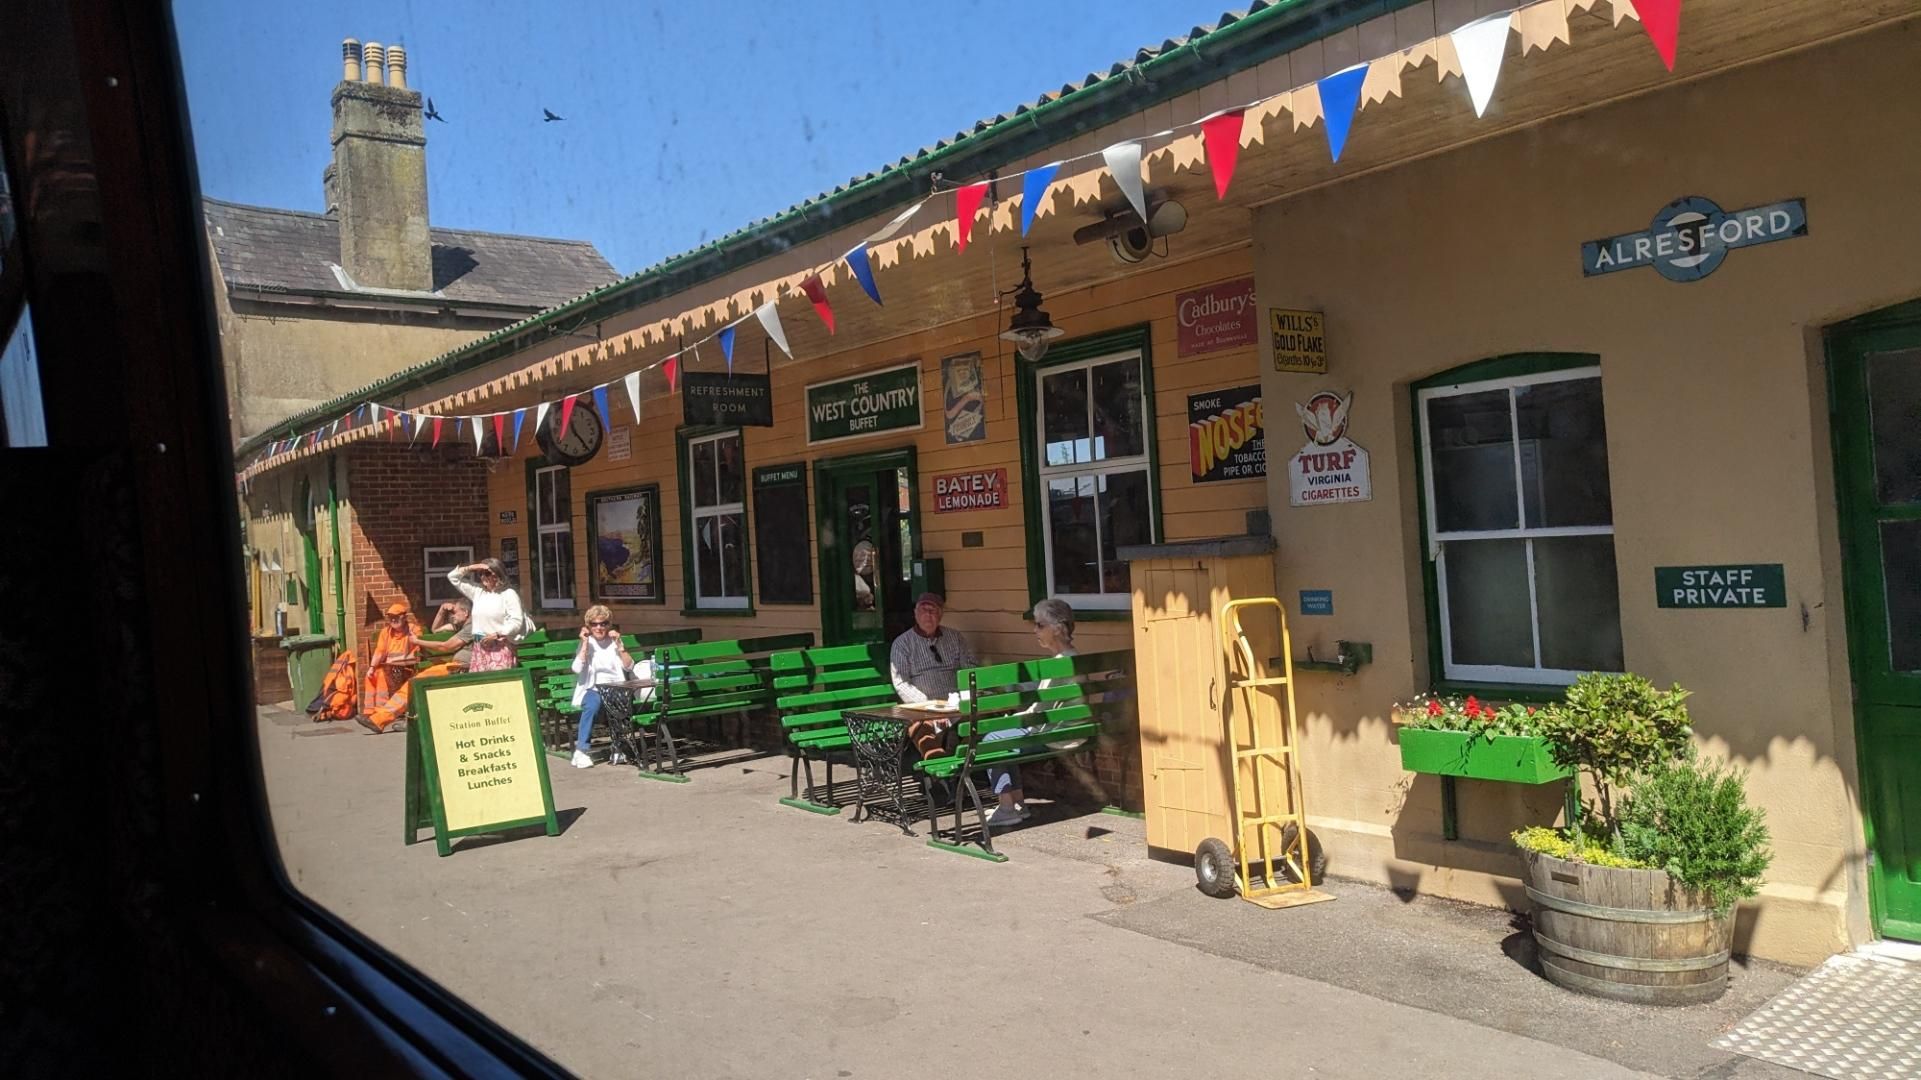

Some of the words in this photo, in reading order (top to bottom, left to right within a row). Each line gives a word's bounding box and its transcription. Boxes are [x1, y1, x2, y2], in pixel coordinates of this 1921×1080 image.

[1594, 210, 1791, 269] ALRESFORD
[1179, 287, 1256, 327] Cadbury's
[1195, 321, 1241, 336] Chocolates
[1274, 332, 1296, 351] GOLD
[1297, 334, 1323, 353] FLAKE
[690, 386, 764, 397] REFRESHMENT
[853, 381, 869, 395] THE
[712, 403, 746, 412] ROOM
[812, 400, 846, 423] WEST
[850, 386, 915, 416] COUNTRY
[1193, 398, 1221, 411] SMOKE
[849, 415, 879, 431] BUFFET
[1298, 448, 1356, 474] TURF
[761, 472, 780, 482] BUFFET
[781, 470, 798, 480] MENU
[1223, 466, 1240, 477] PIPE
[1242, 464, 1253, 474] OR
[936, 472, 997, 494] BATEY
[1308, 473, 1352, 486] VIRGINIA
[939, 492, 1000, 509] LEMONADE
[1302, 486, 1360, 501] CIGARETTES
[1682, 569, 1753, 586] STAFF
[1673, 587, 1766, 604] PRIVATE
[449, 719, 481, 731] Station
[485, 715, 512, 727] Buffet
[456, 739, 476, 750] Hot
[480, 734, 516, 746] Drinks
[460, 754, 468, 763] &
[473, 748, 512, 761] Snacks
[457, 760, 518, 777] Breakfasts
[468, 775, 513, 790] Lunches
